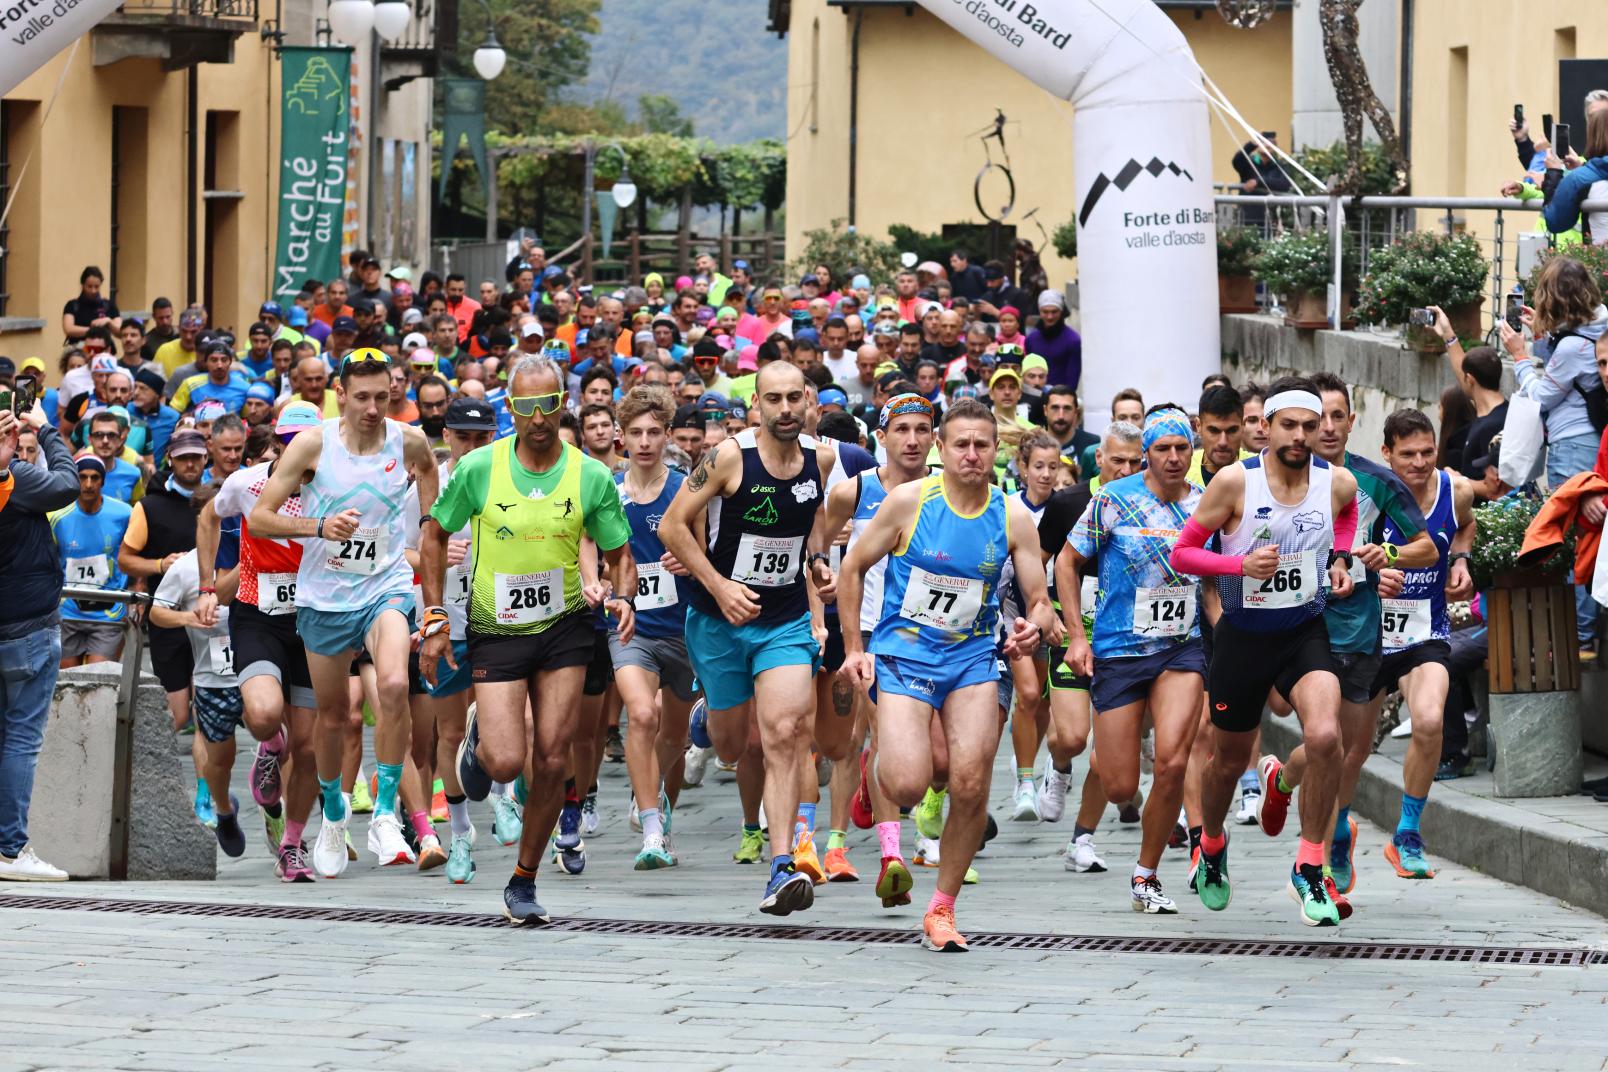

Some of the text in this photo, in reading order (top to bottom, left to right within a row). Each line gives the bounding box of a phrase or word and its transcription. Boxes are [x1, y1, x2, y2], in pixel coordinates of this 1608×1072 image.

[0, 0, 42, 30] Fort
[965, 0, 1025, 48] d'aosta
[12, 15, 54, 46] valle
[1017, 3, 1072, 50] Bard
[276, 156, 318, 297] Marché
[315, 211, 332, 243] au
[1123, 211, 1171, 228] Forte
[1175, 208, 1191, 225] di
[1125, 229, 1206, 249] valle d'aosta
[339, 540, 377, 561] 274
[764, 539, 794, 547] GENERALI
[327, 558, 345, 568] CIDAC
[752, 551, 790, 574] 139
[1278, 552, 1303, 562] NERALI
[77, 565, 96, 579] 74
[516, 571, 552, 582] GENERALI
[933, 574, 970, 587] GENERALI
[1259, 567, 1302, 593] 266
[1404, 570, 1440, 585] NERGY
[276, 583, 297, 602] 69
[638, 575, 660, 597] 87
[508, 585, 551, 610] 286
[927, 588, 958, 614] 77
[1245, 595, 1267, 603] CIDAC
[497, 612, 519, 620] CIDAC
[1150, 599, 1186, 622] 124
[1383, 612, 1410, 633] 57
